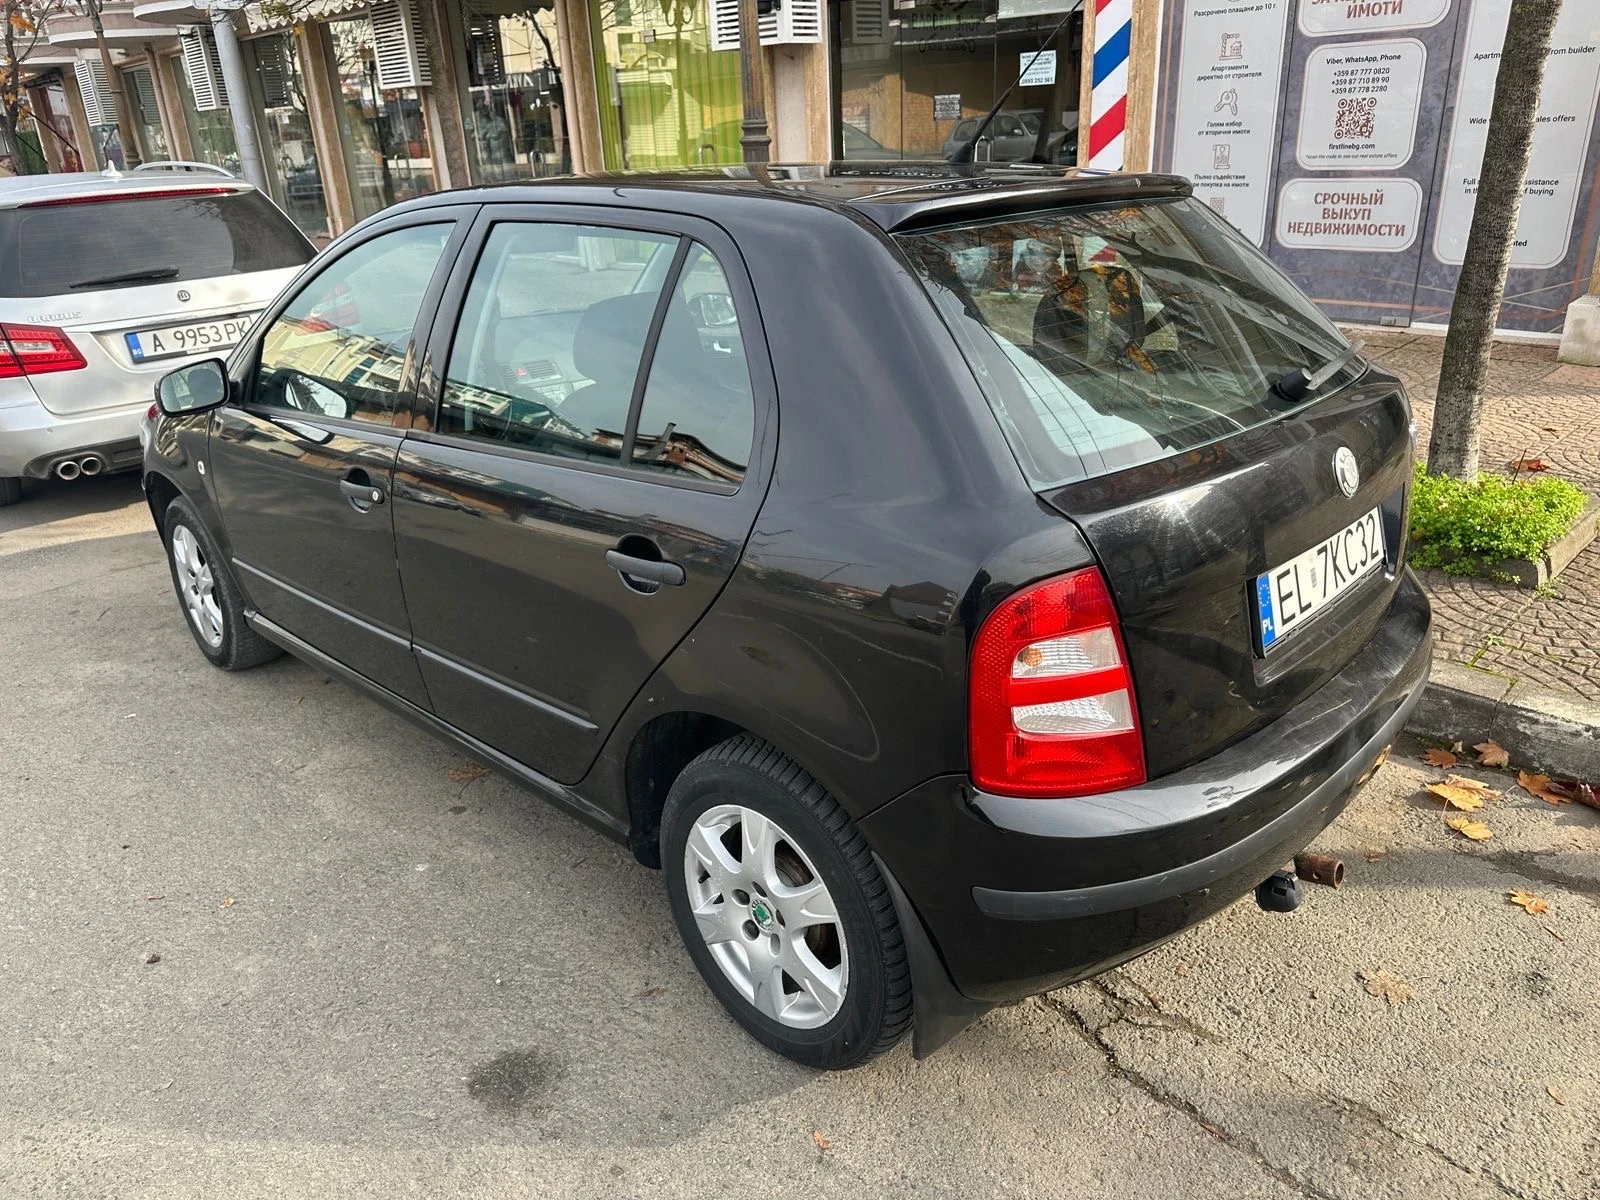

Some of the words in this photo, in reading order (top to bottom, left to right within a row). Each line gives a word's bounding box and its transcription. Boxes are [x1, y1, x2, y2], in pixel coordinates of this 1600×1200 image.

[1228, 6, 1254, 14] плащане
[1346, 0, 1403, 18] ИМОТИ
[1473, 52, 1501, 60] Apartm
[1568, 45, 1596, 54] builder
[1345, 56, 1378, 64] WhatsApp,
[1197, 74, 1223, 82] директно
[1232, 71, 1262, 79] строителя
[1373, 67, 1390, 75] 0820
[1331, 87, 1347, 95] +359
[1371, 85, 1388, 93] 2280
[1536, 115, 1551, 123] ales
[1552, 115, 1576, 123] offers
[1313, 188, 1384, 205] СРОЧНЫЙ
[1529, 188, 1554, 196] buying
[1322, 207, 1371, 220] ВЫКУП
[1287, 221, 1405, 237] НЕДВИЖИМОСТИ
[152, 333, 165, 352] A
[173, 325, 223, 348] 9953
[224, 320, 246, 341] PK
[132, 348, 143, 356] BG
[1276, 564, 1312, 626] EL
[1317, 513, 1379, 599] 7KC32
[1262, 618, 1273, 634] PL
